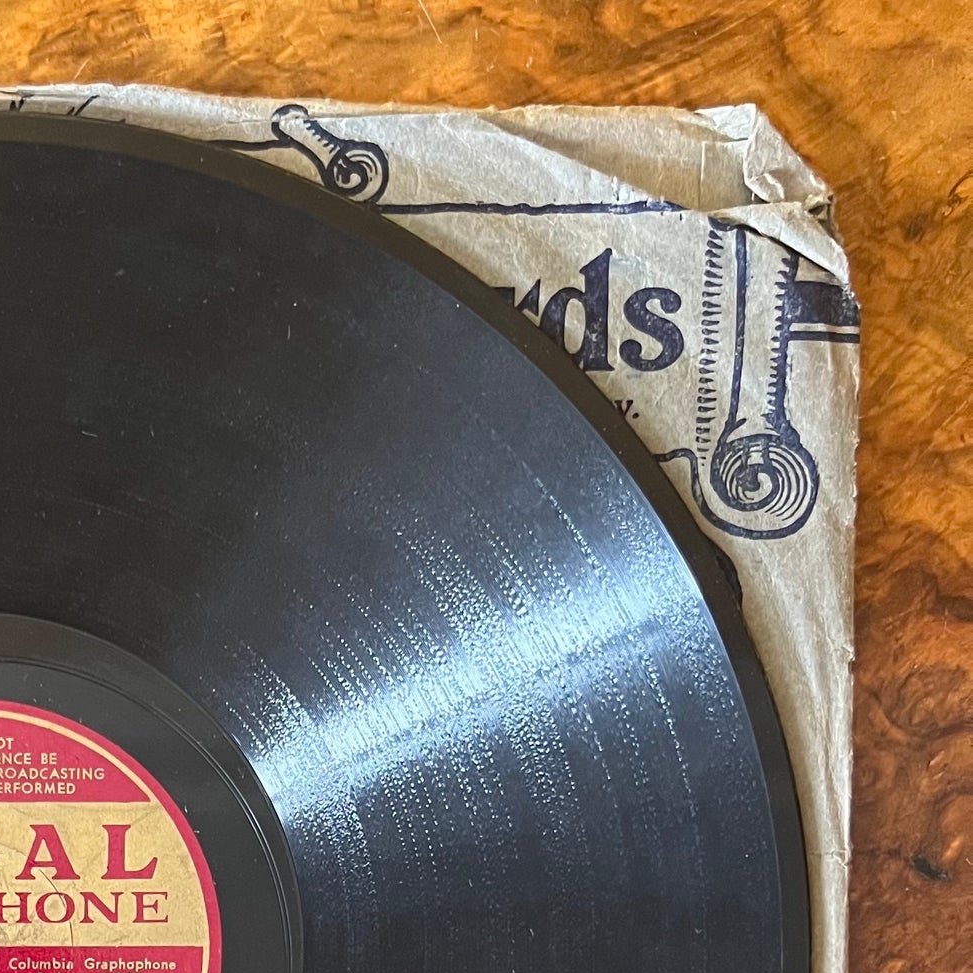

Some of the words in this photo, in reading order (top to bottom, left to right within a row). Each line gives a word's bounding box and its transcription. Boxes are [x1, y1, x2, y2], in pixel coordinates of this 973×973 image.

[40, 752, 58, 765] BE
[8, 957, 74, 970] Columbia
[84, 957, 177, 972] Graphophone
